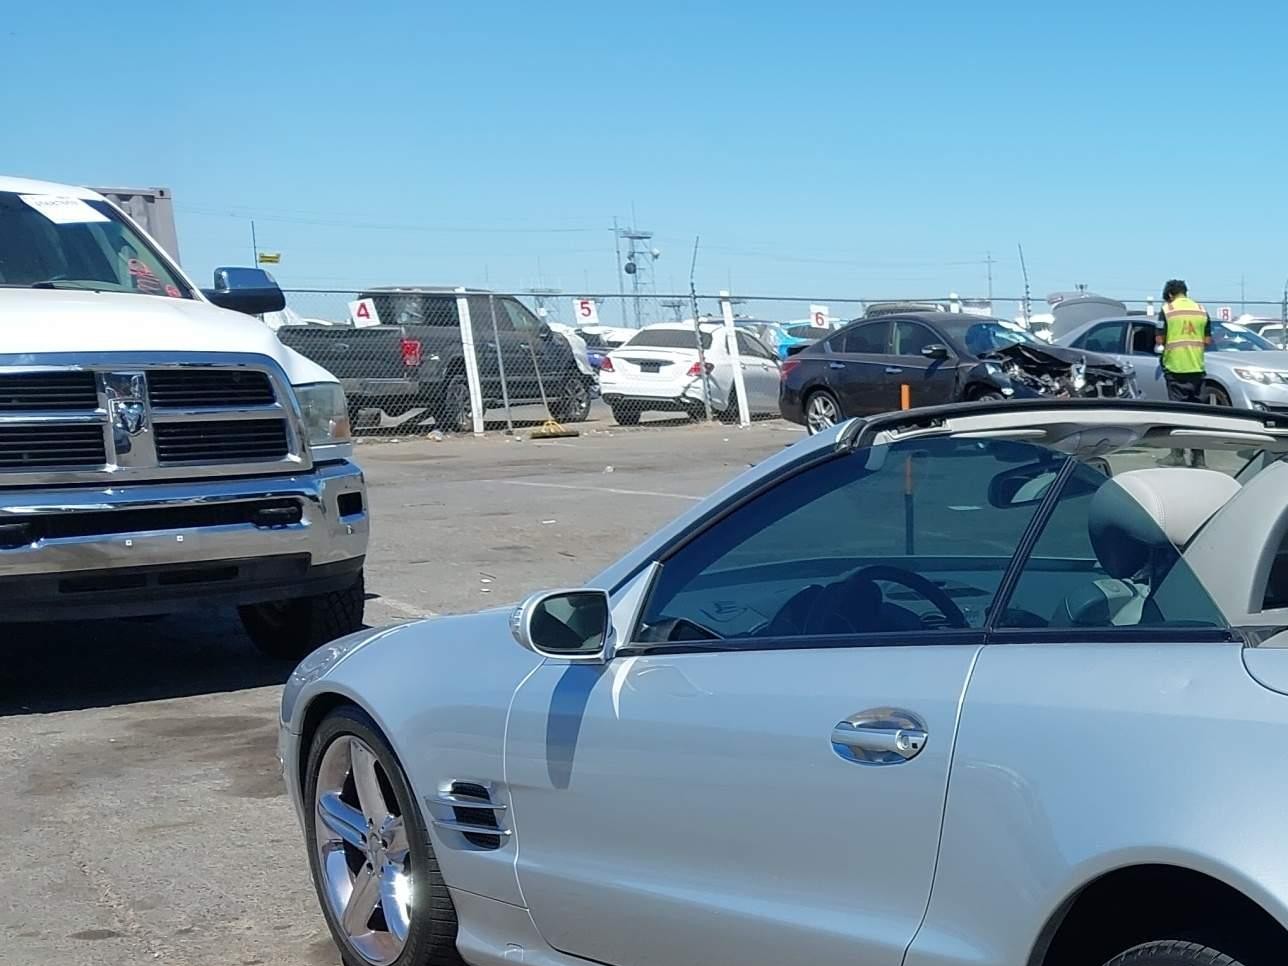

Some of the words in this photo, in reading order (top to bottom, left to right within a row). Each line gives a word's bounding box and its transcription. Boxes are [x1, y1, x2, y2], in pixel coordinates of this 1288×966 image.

[357, 302, 370, 320] 4
[580, 300, 592, 317] 5
[815, 311, 825, 327] 6
